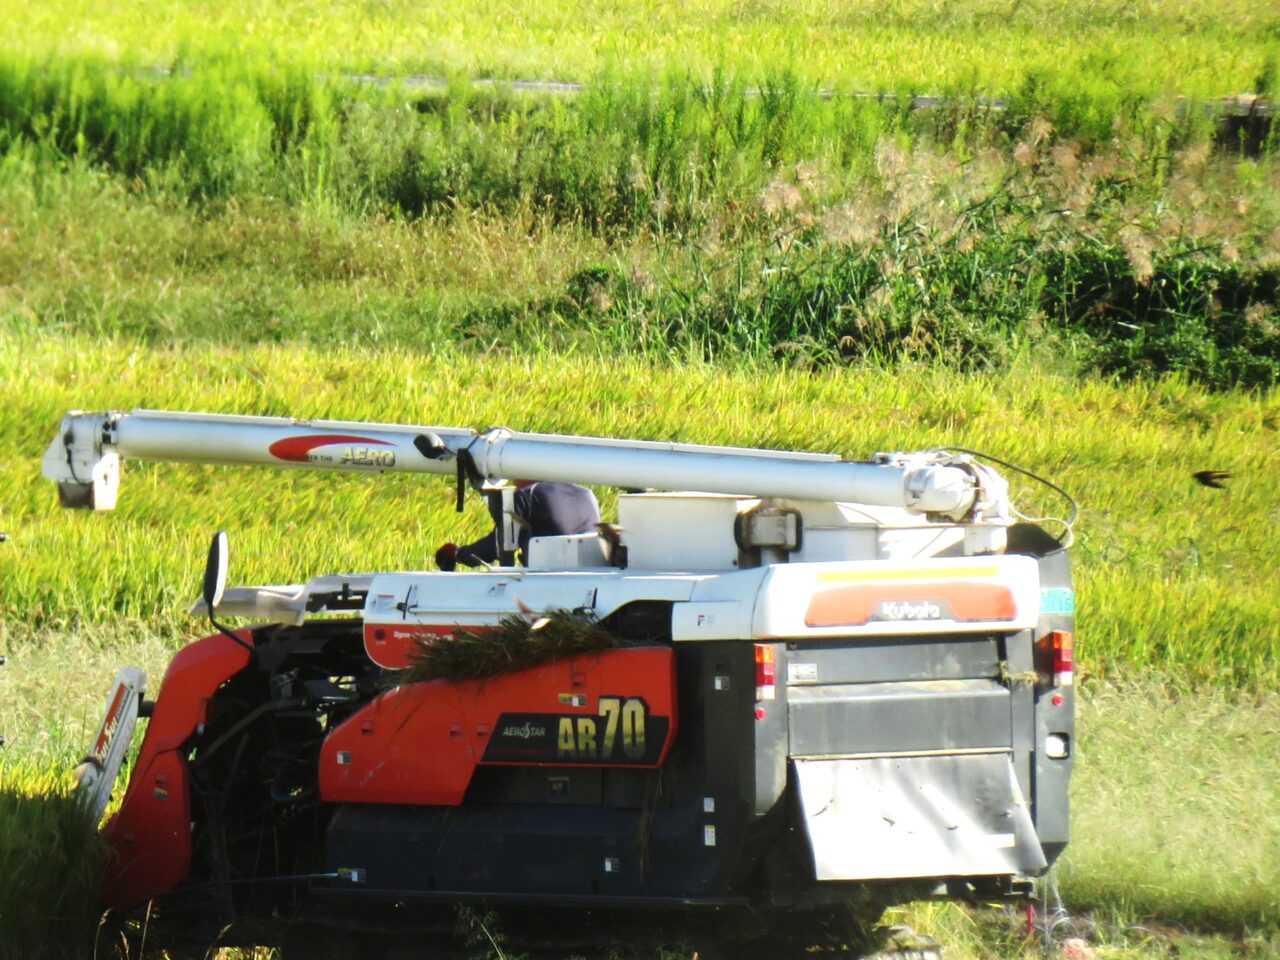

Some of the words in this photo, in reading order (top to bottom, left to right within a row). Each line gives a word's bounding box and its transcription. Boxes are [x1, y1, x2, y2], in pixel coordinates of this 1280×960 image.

[341, 447, 396, 467] AERO
[883, 601, 940, 619] Kubota
[502, 722, 546, 739] AEROSTAR
